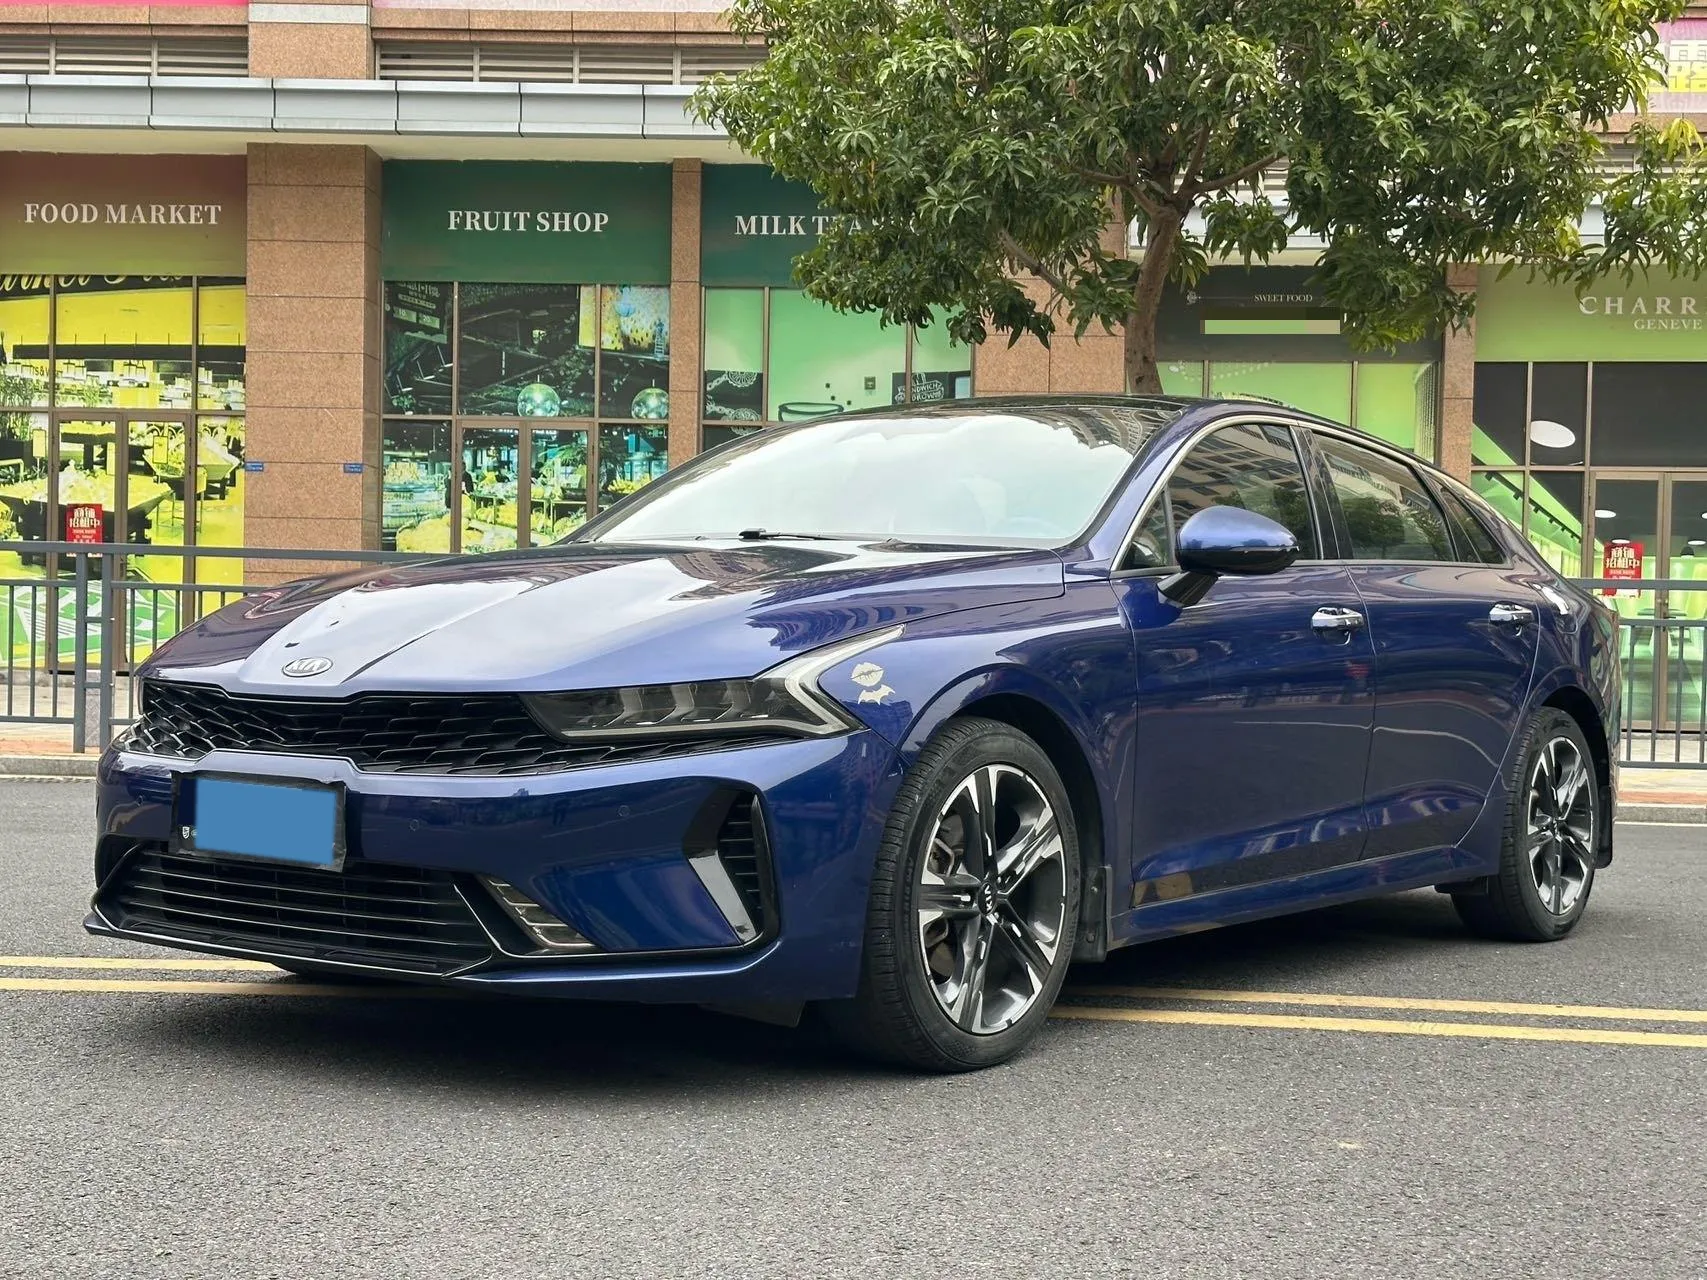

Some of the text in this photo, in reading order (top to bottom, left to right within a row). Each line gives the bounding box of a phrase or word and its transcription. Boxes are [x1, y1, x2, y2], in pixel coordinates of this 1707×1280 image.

[24, 203, 222, 225] FOOD MARKET
[448, 210, 609, 234] FRUIT SHOP
[734, 215, 807, 236] MILK
[811, 215, 864, 236] TA
[1254, 294, 1313, 303] SWEET FOOD
[1579, 296, 1707, 315] CHARR
[1633, 318, 1703, 331] GENEVE
[284, 658, 331, 674] KIA
[984, 884, 993, 912] KIA
